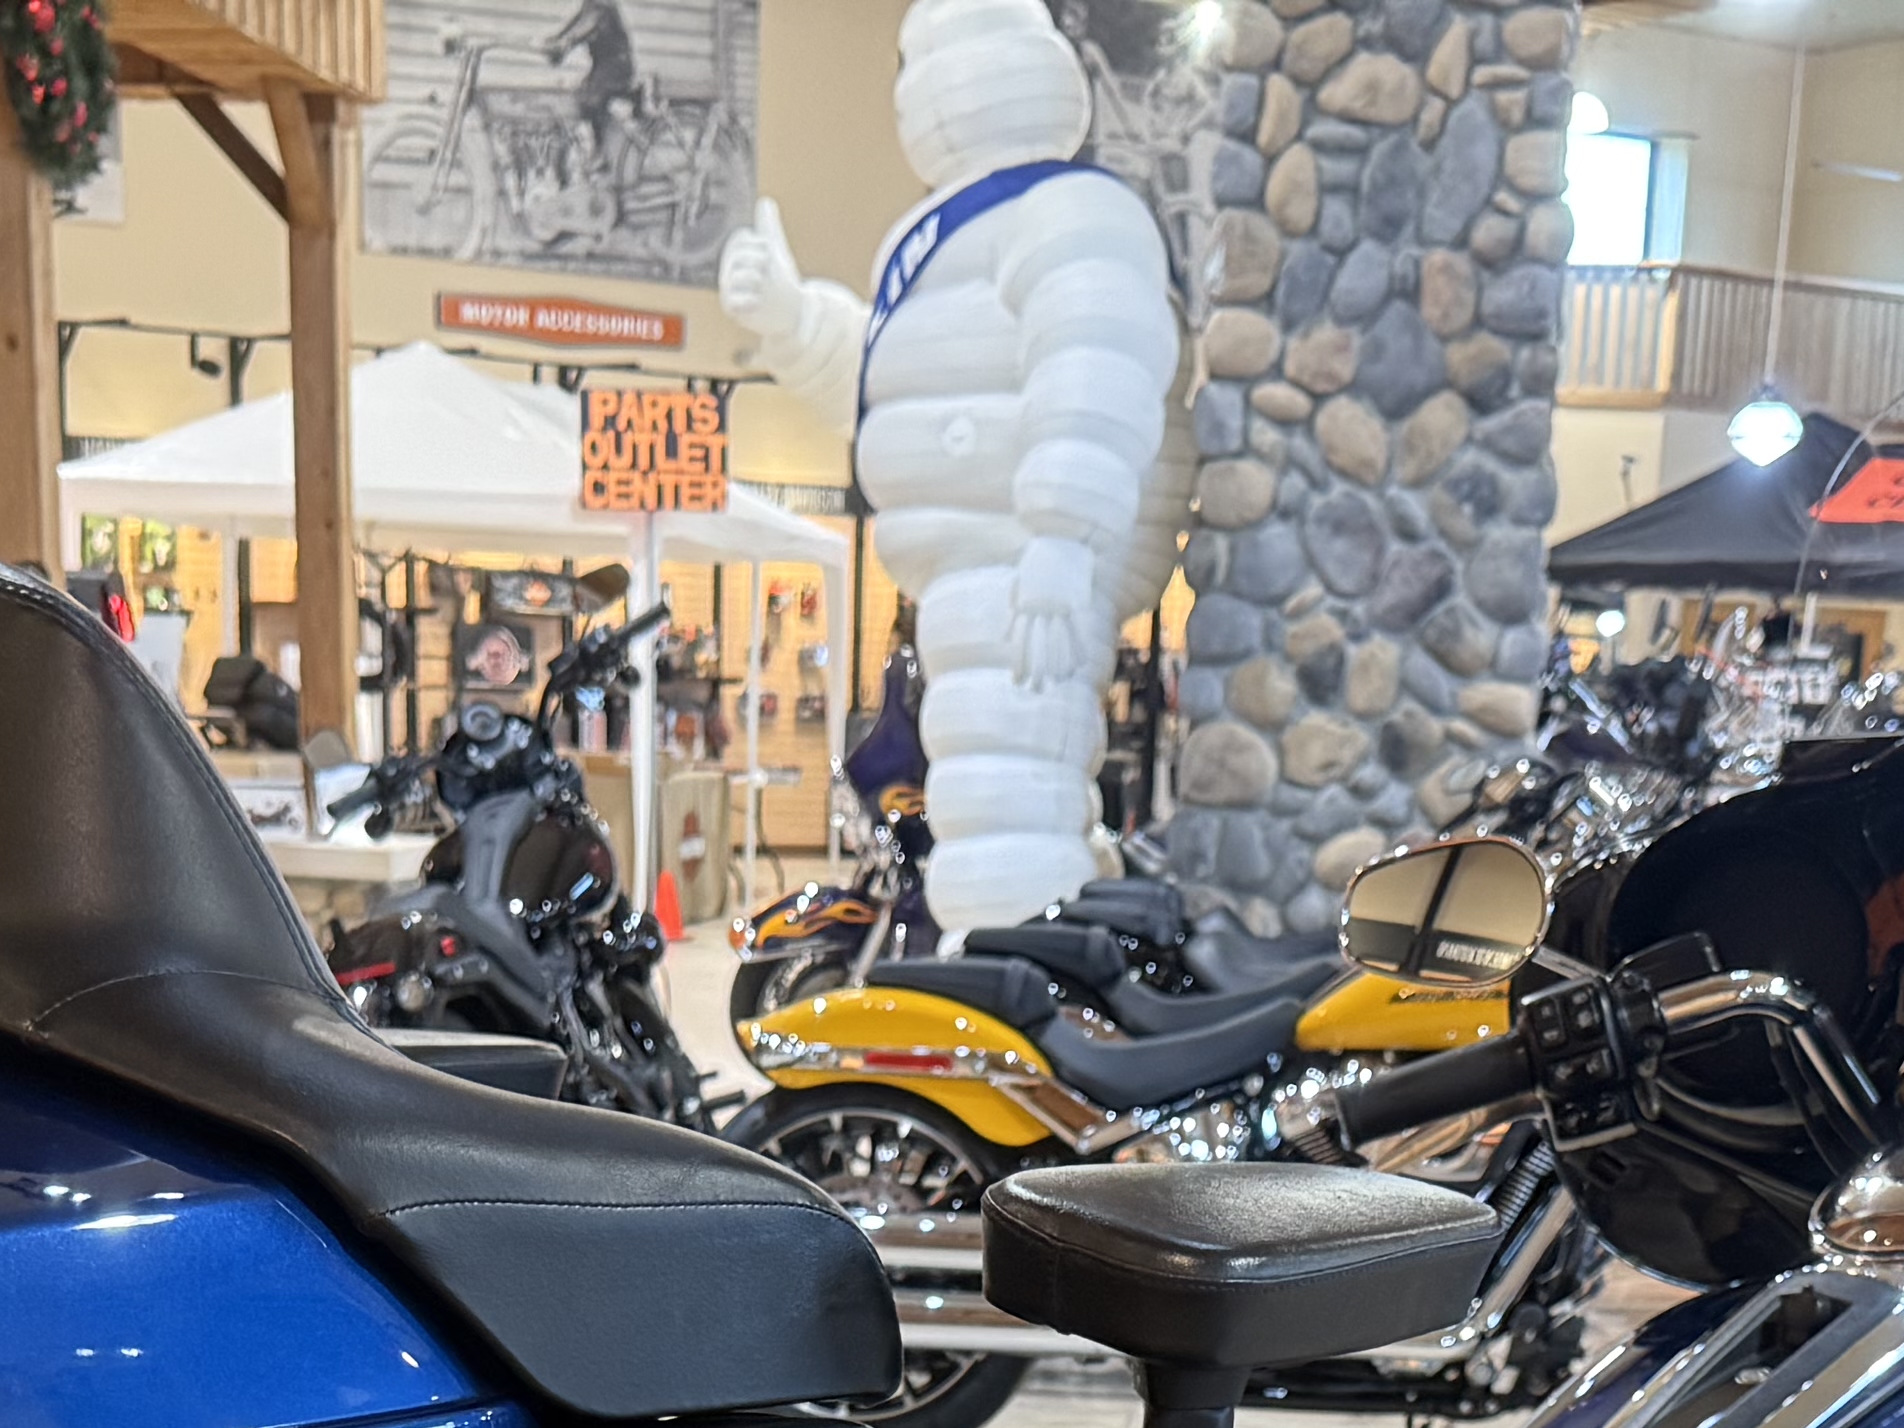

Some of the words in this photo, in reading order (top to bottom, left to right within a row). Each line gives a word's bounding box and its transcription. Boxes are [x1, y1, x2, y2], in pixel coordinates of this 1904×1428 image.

[460, 302, 530, 328] MOTOR
[535, 308, 664, 341] ACCESSORIES
[589, 390, 720, 434] PARTS
[584, 431, 728, 475] OUTLET
[584, 470, 728, 512] CENTER
